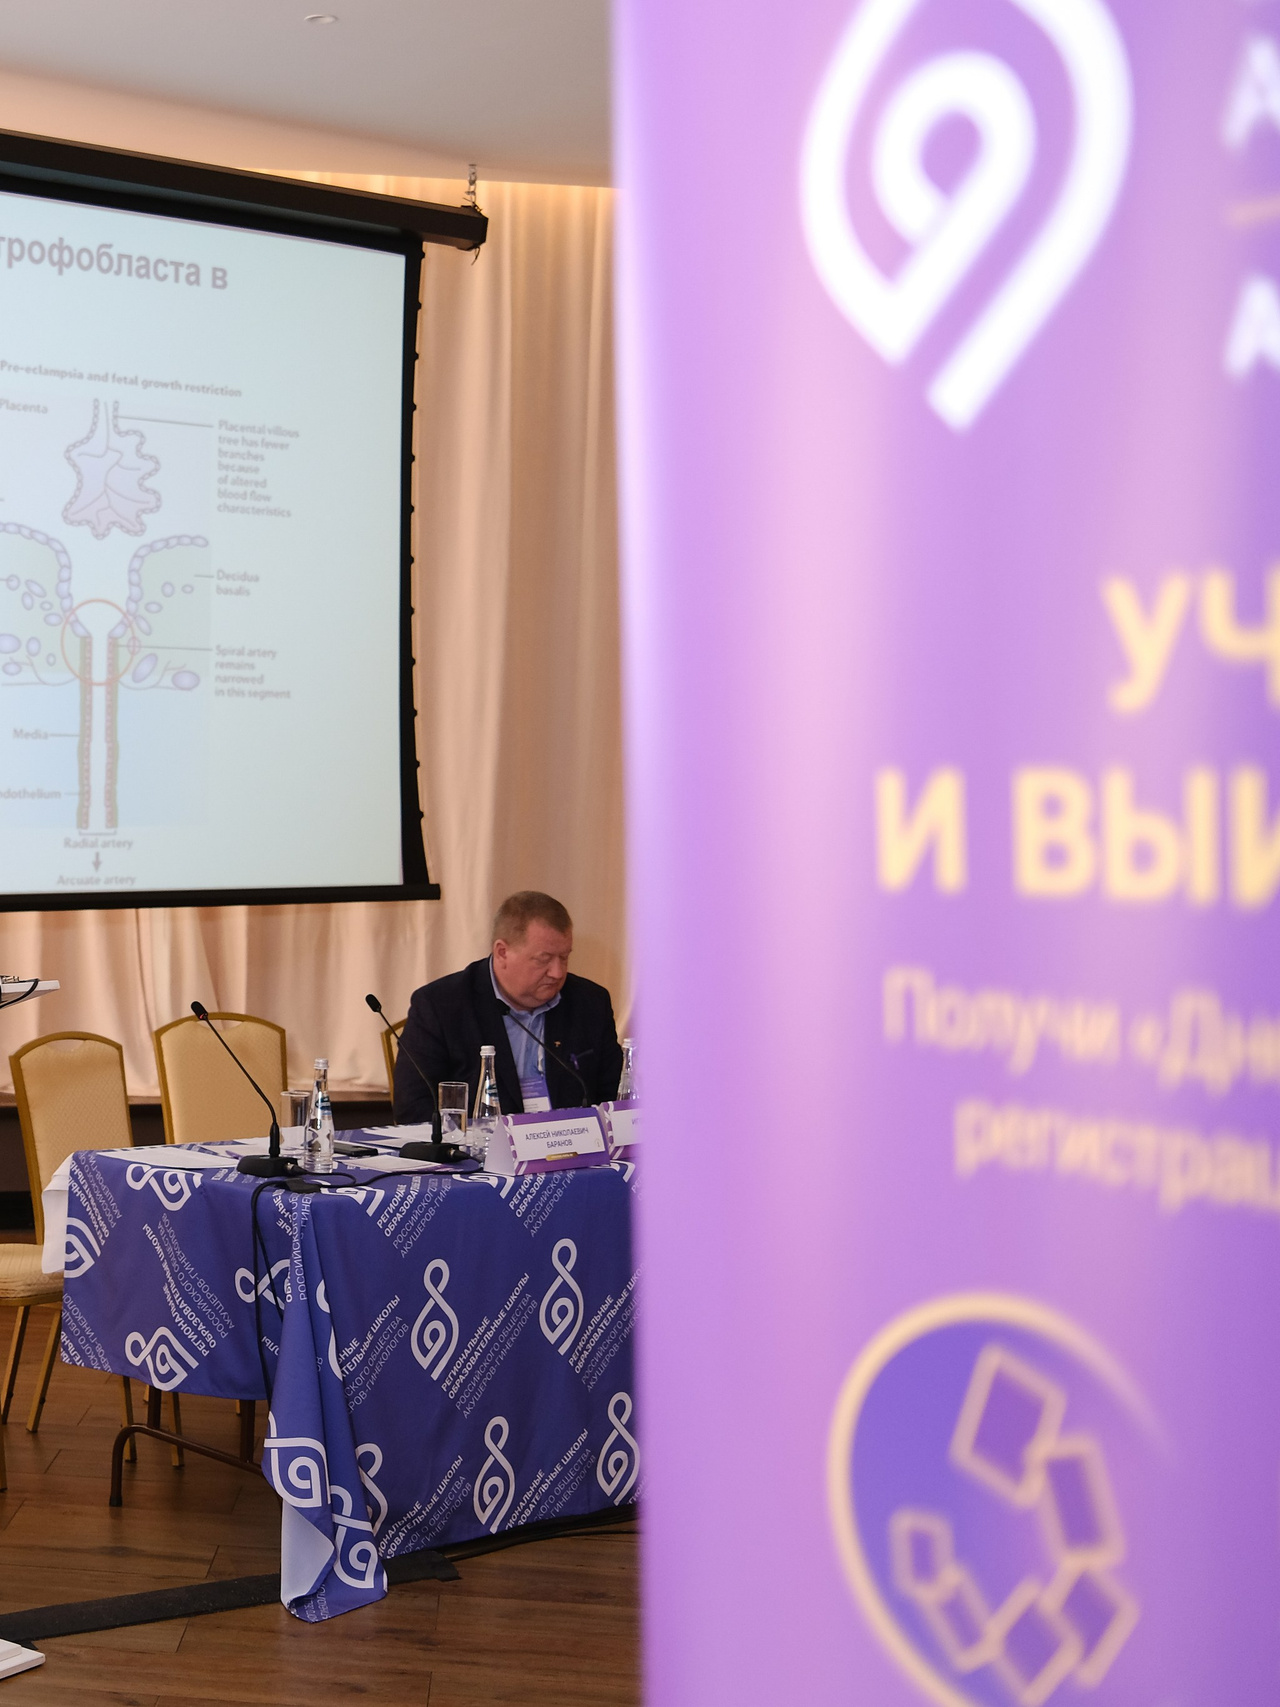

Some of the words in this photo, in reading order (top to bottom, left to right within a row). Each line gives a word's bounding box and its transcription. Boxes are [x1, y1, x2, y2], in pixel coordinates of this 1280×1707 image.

[210, 263, 229, 291] в
[0, 359, 84, 381] Pre-eclampsia
[87, 371, 109, 384] and
[141, 377, 183, 391] growth
[184, 383, 243, 398] restriction
[218, 419, 266, 435] Placental
[12, 728, 49, 741] Media
[63, 836, 98, 848] Radial
[100, 838, 134, 850] artery
[371, 1294, 401, 1334] ШКОЛЫ
[448, 1309, 507, 1399] ОБРАЗОВАТЕЛЬНЫЕ
[504, 1272, 530, 1312] ШКОЛЫ
[568, 1295, 614, 1367] РЕГИОНАЛЬНЫЕ
[574, 1288, 629, 1374] ОБРАЗОВАТЕЛЬНЫЕ
[368, 1315, 403, 1366] ОБЩЕСТВА
[441, 1315, 491, 1392] РЕГИОНАЛЬНЫЕ
[455, 1342, 500, 1410] РОССИЙСКОГО
[498, 1293, 532, 1343] ОБЩЕСТВА
[462, 1299, 538, 1419] АКУШЕРОВ-ГИНЕКОЛОГОВ
[581, 1320, 623, 1385] РОССИЙСКОГО
[560, 1428, 589, 1466] ШКОЛЫ
[436, 1454, 464, 1495] ШКОЛЫ
[553, 1448, 592, 1496] ОБЩЕСТВА
[428, 1475, 466, 1527] ОБЩЕСТВА
